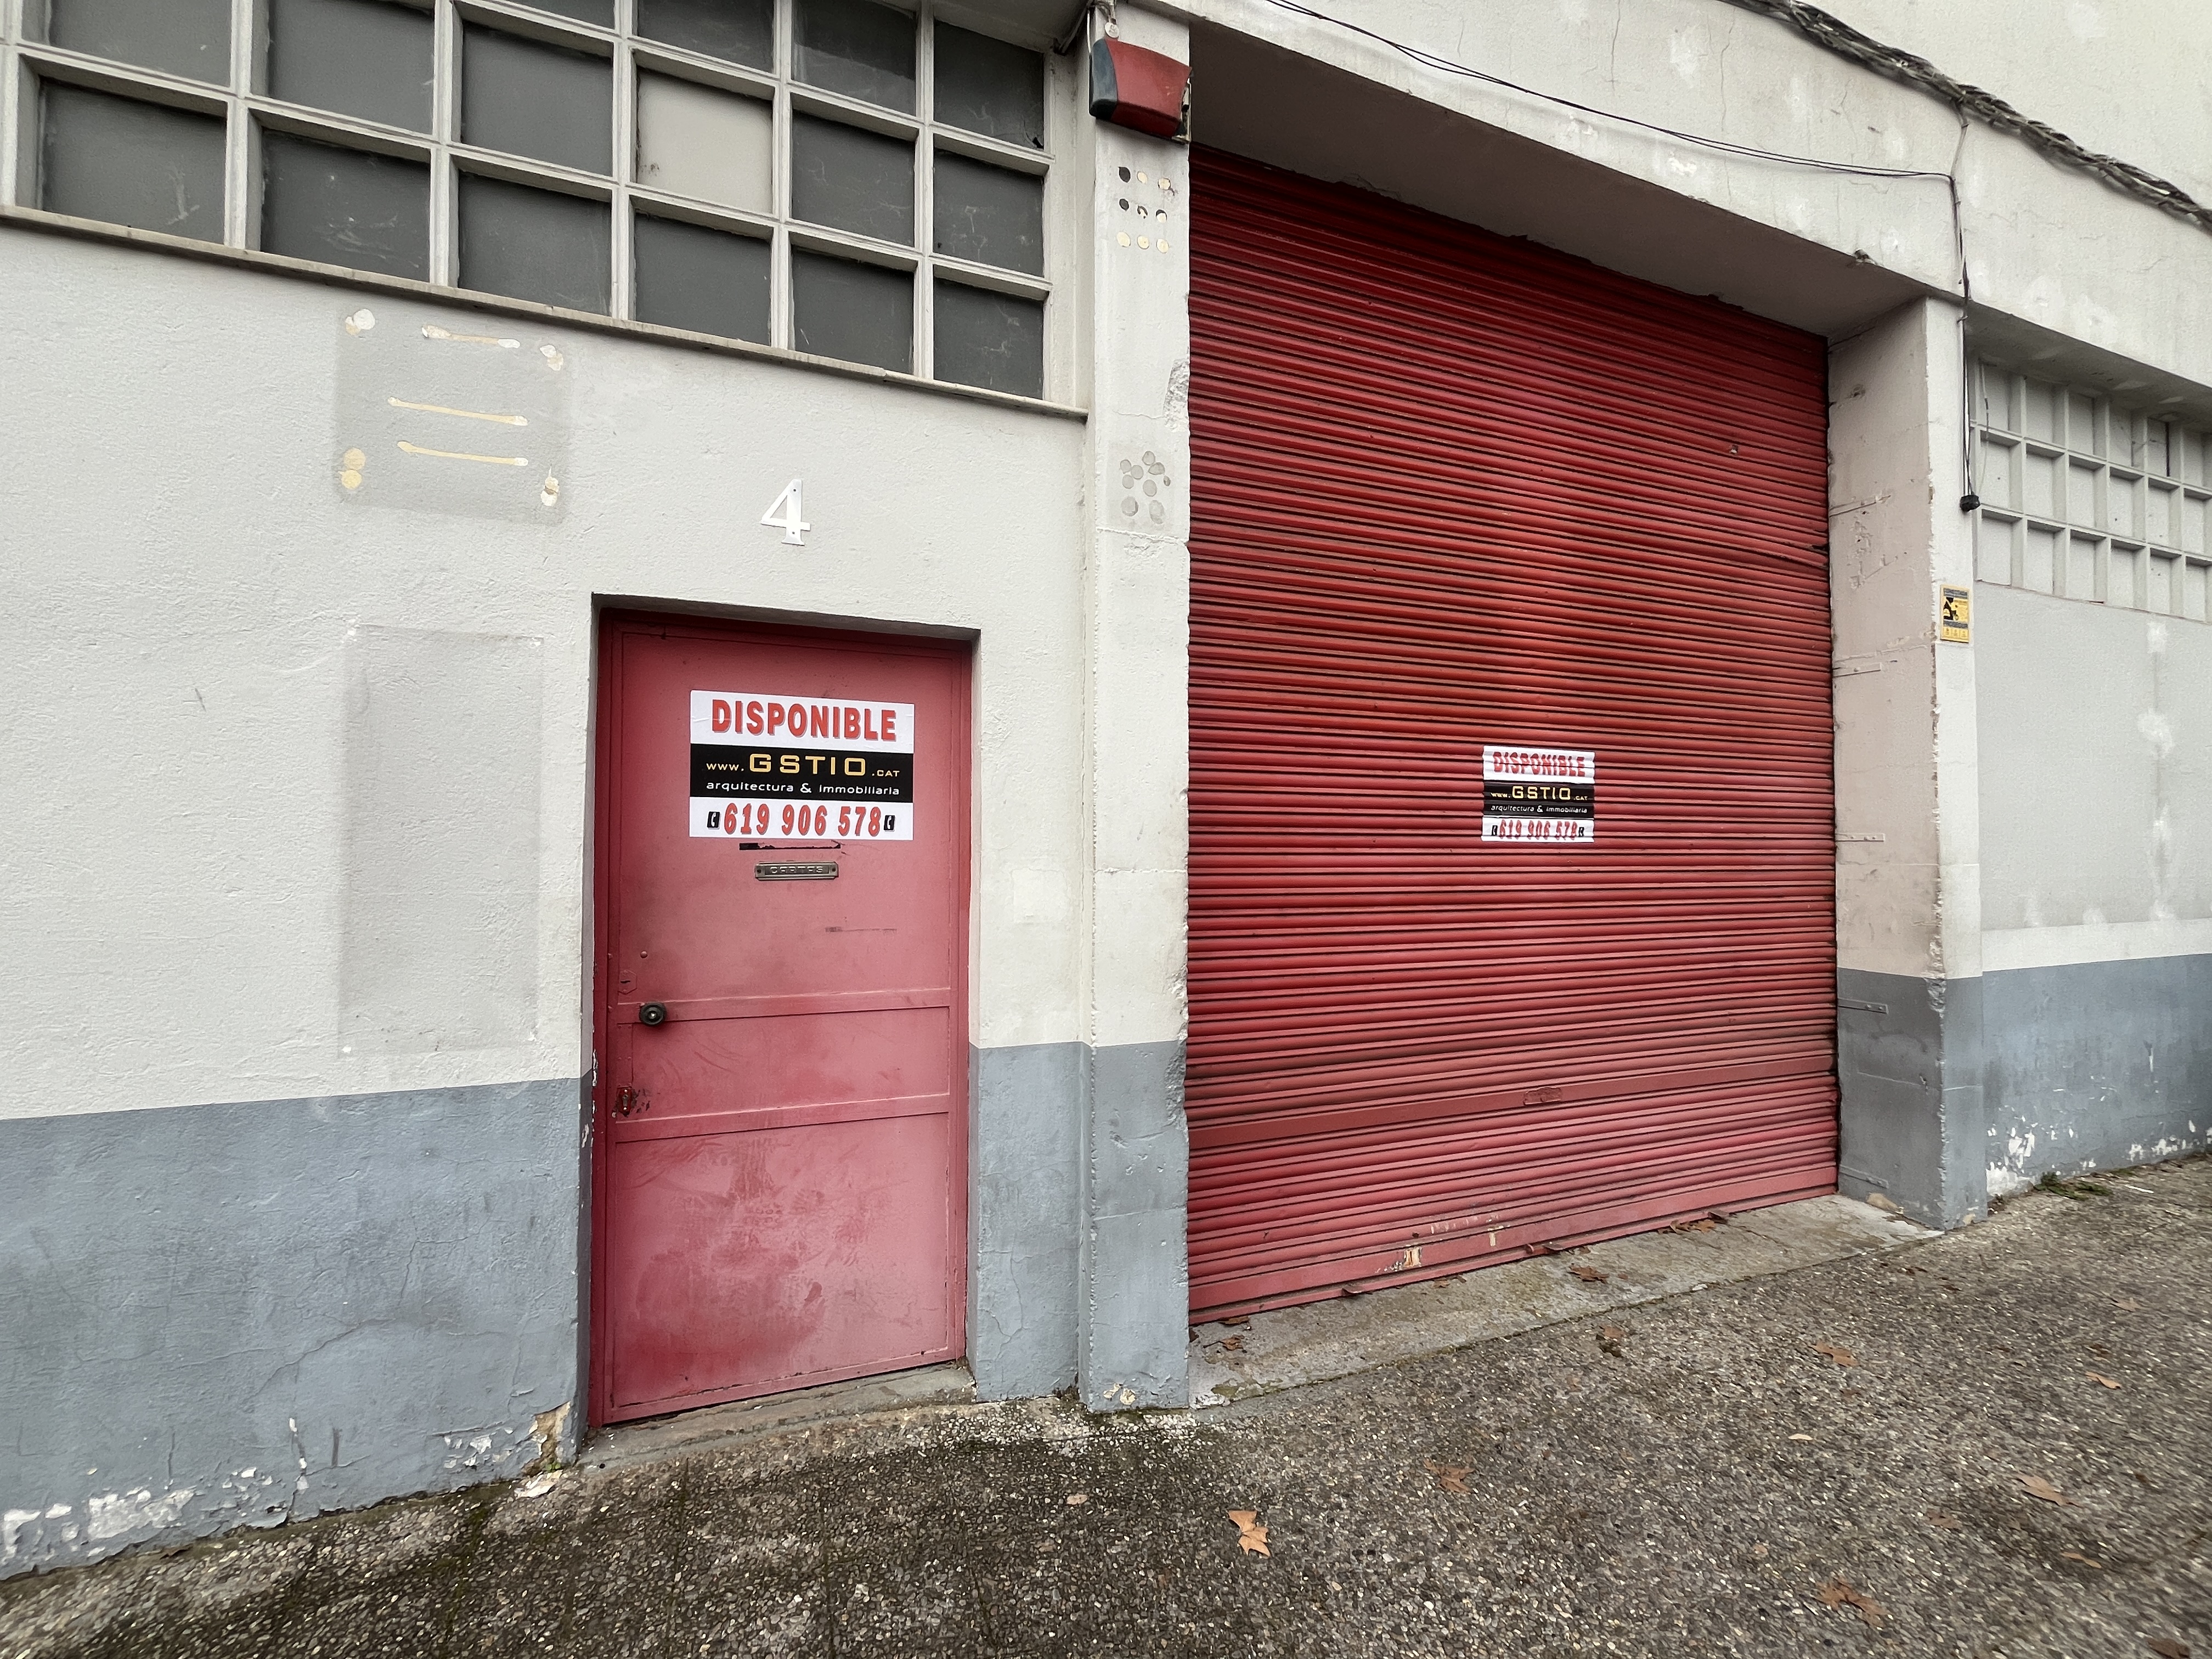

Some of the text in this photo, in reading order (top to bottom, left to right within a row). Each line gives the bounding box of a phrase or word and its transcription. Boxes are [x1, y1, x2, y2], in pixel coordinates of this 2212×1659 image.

[761, 479, 810, 546] 4
[712, 699, 897, 742] DISPONIBLE
[1493, 751, 1585, 777] DISPONIBLE
[706, 781, 900, 795] arquitectura & immobiliaria
[724, 803, 881, 837] 619 906 578
[1499, 819, 1578, 840] 619 906 578
